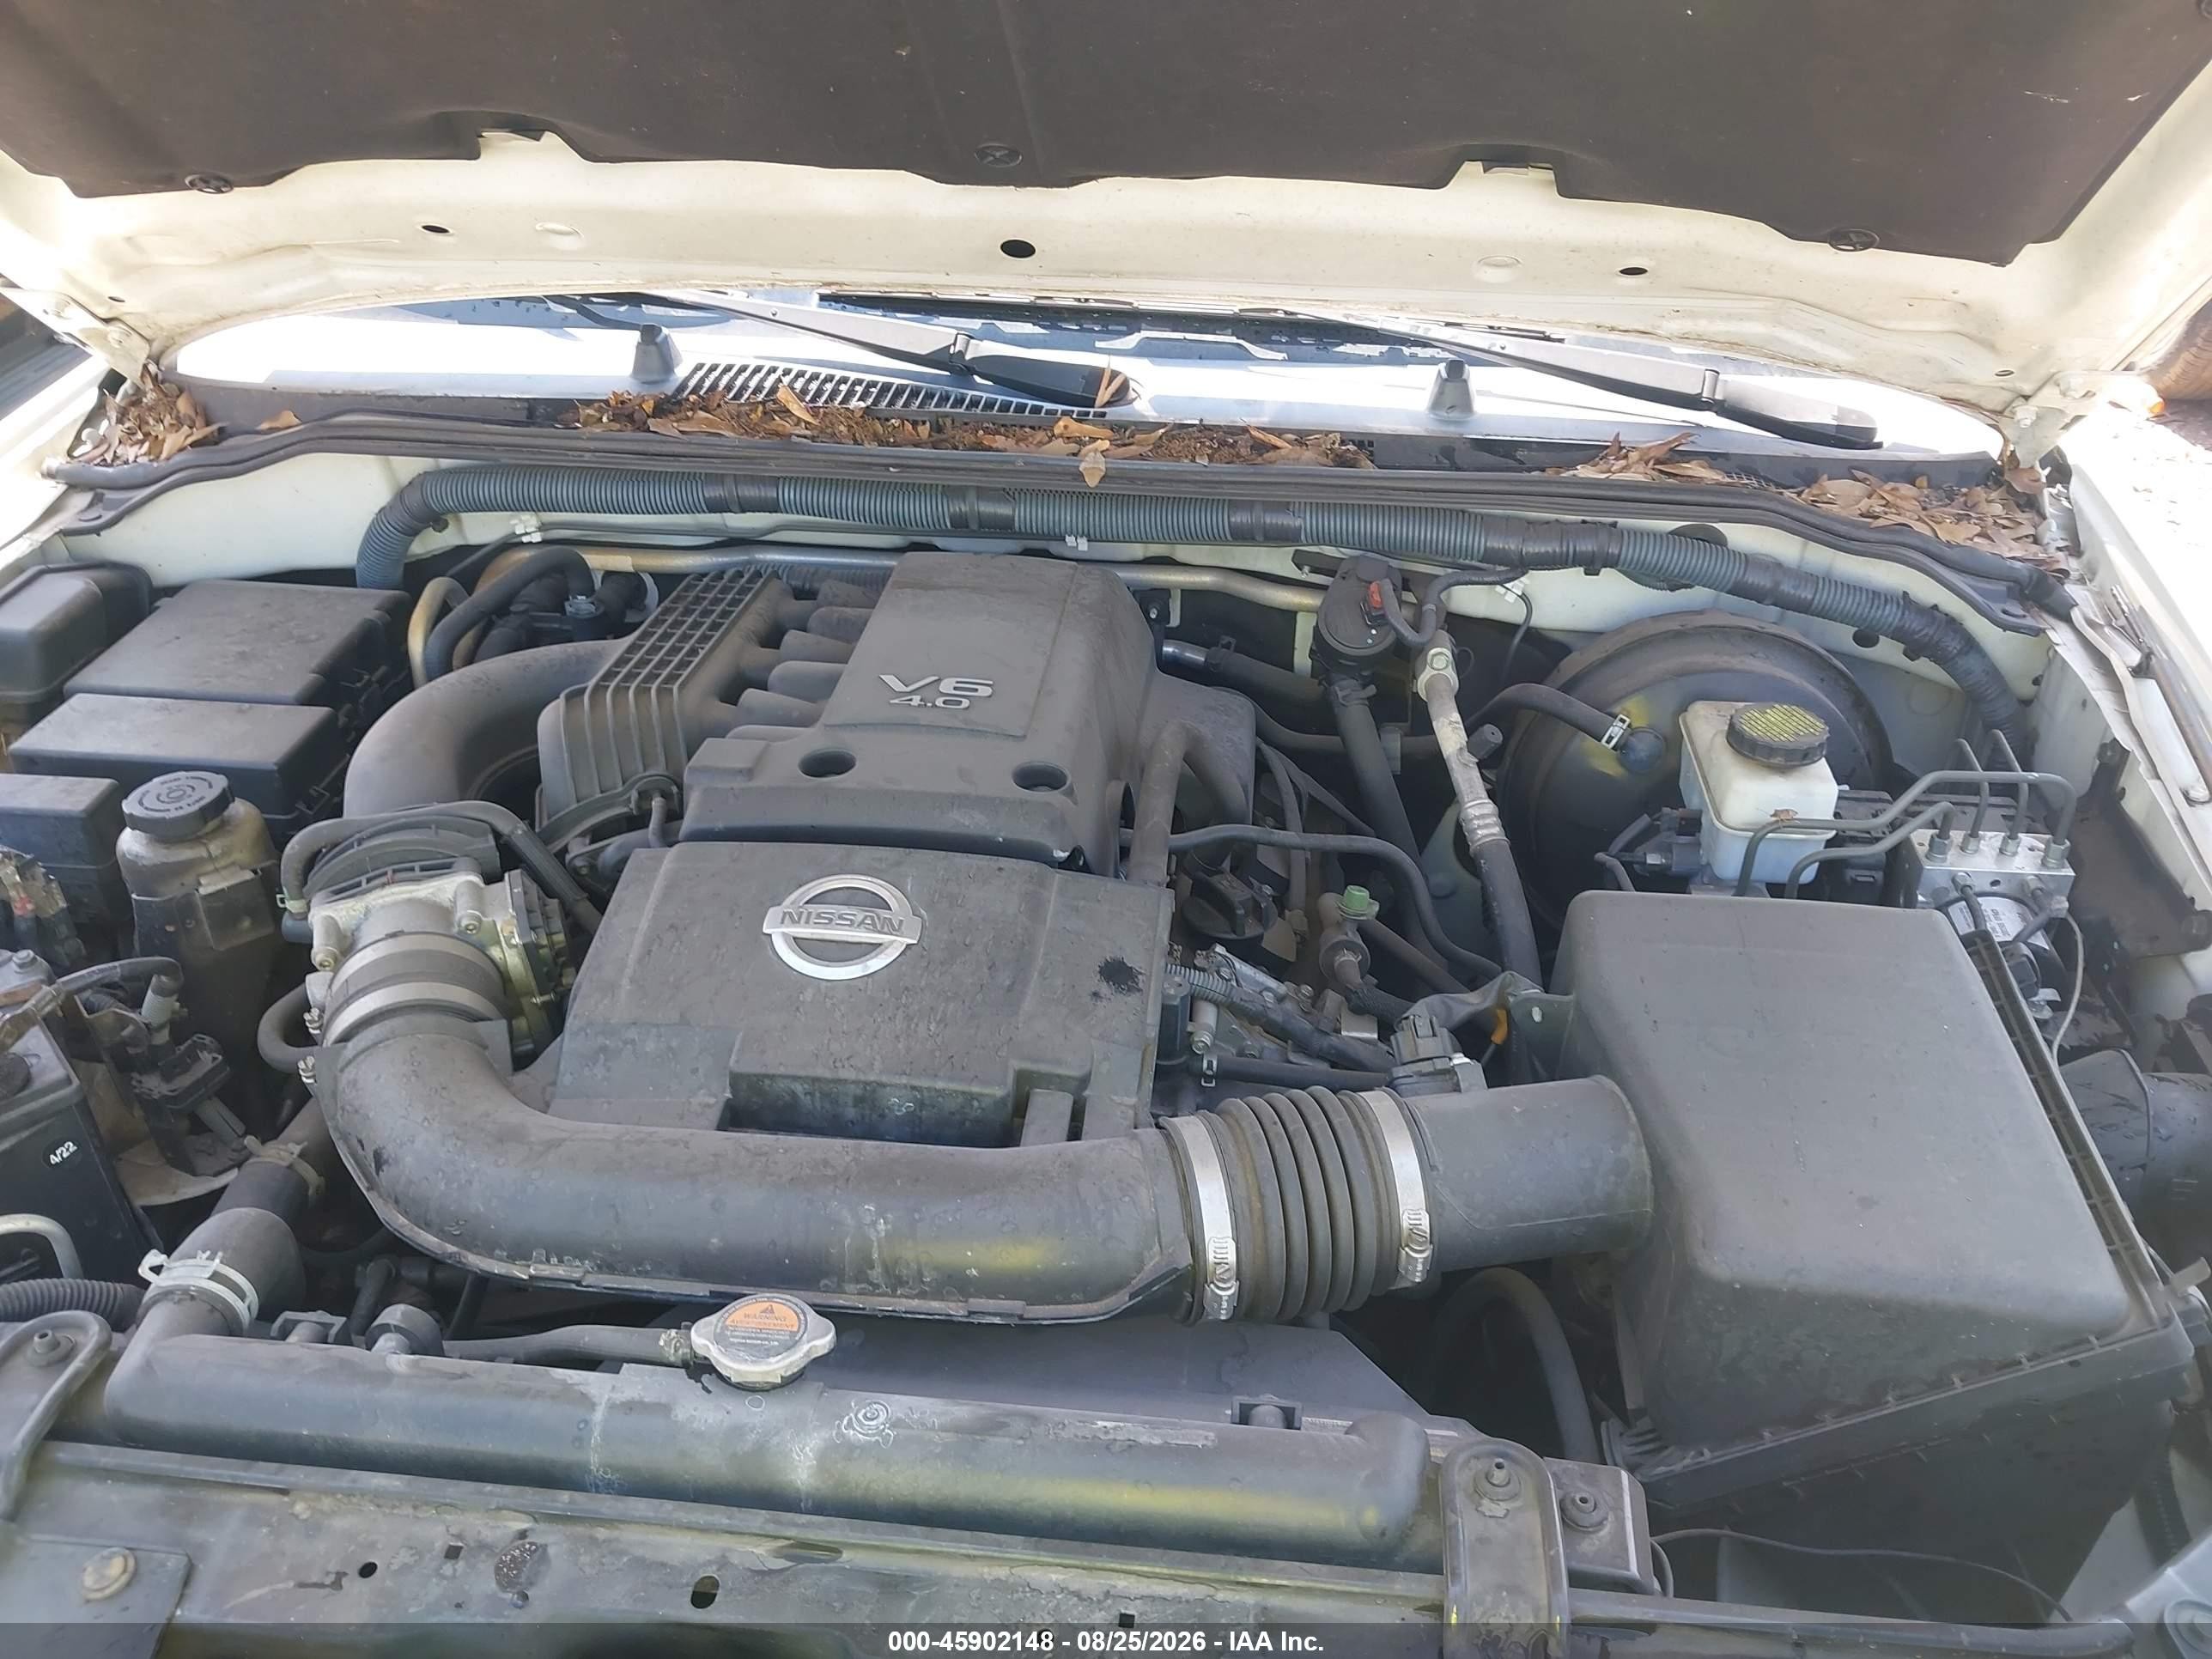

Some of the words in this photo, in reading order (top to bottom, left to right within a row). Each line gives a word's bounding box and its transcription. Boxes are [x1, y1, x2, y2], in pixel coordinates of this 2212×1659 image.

[878, 674, 994, 697] V6
[890, 695, 970, 708] 4.0
[780, 908, 903, 934] NISSAN
[49, 1140, 78, 1164] 4/22
[743, 1312, 787, 1322] WARNING
